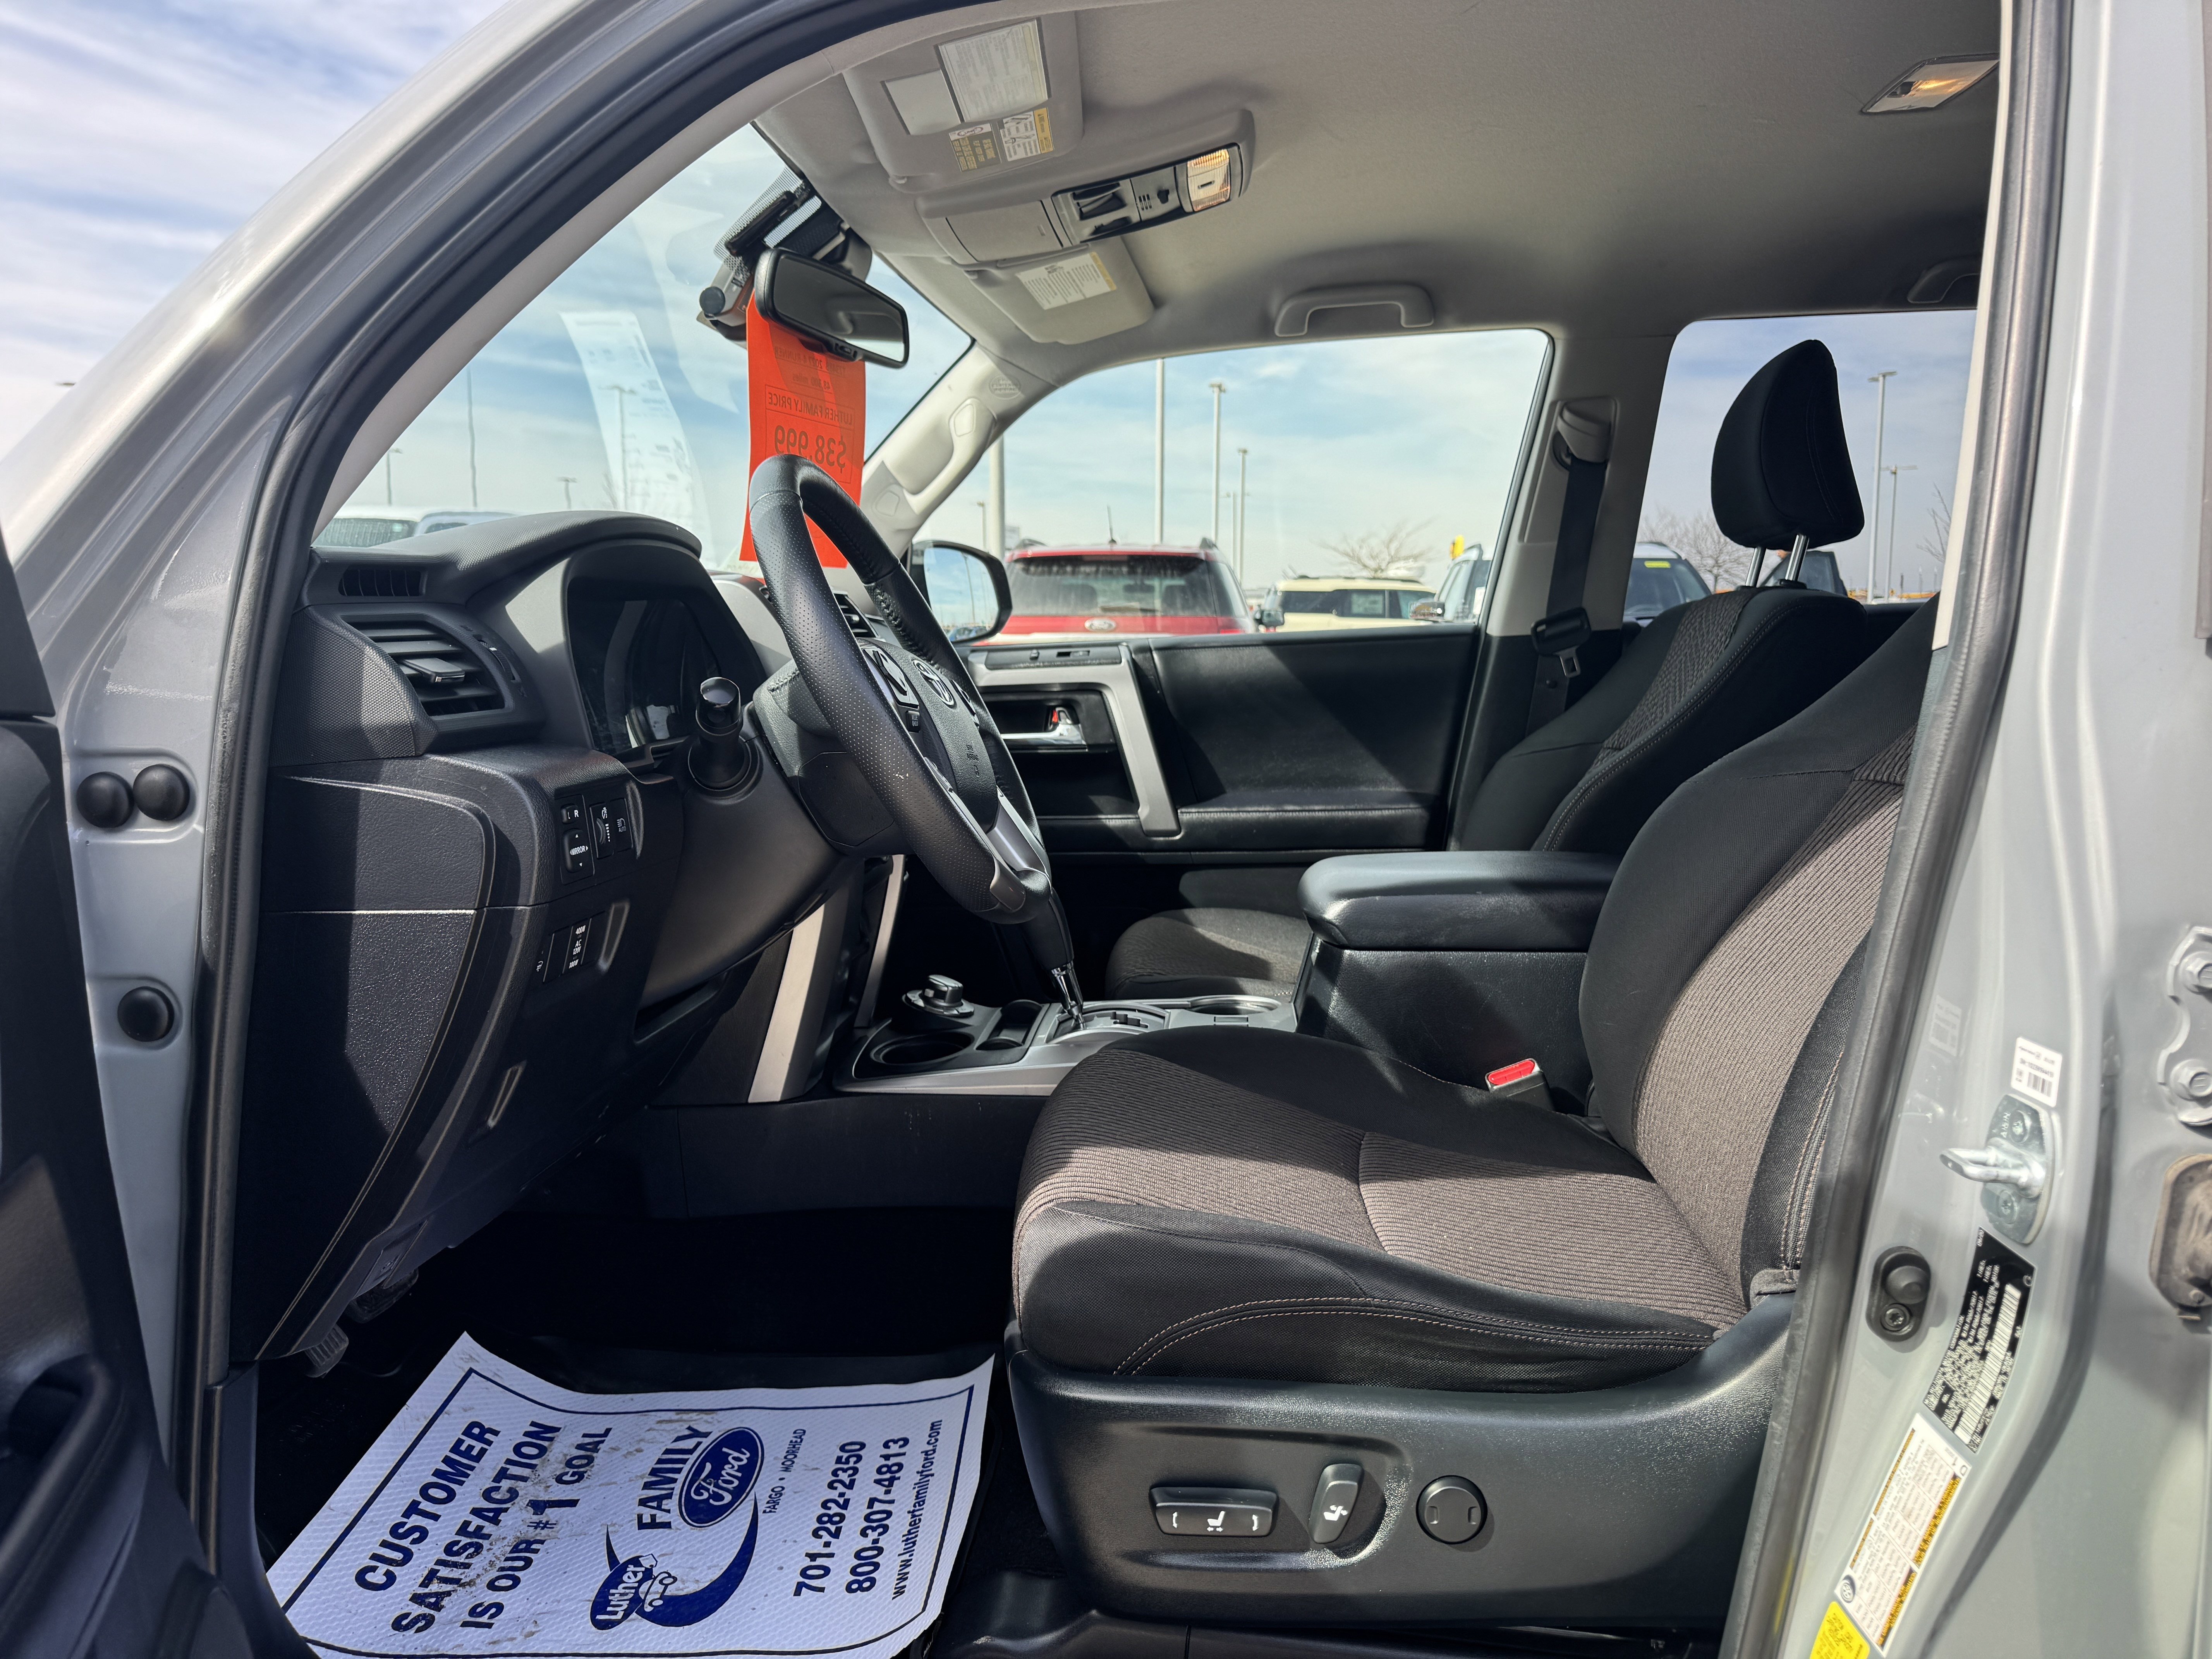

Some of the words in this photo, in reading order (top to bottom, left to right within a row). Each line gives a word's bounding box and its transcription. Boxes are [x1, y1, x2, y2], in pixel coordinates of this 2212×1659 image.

[575, 939, 582, 948] AC
[355, 1421, 501, 1592] CUSTOMER
[391, 1421, 562, 1633] SATISFACTION
[459, 1602, 505, 1629] IS
[486, 1538, 544, 1592] OUR
[527, 1499, 580, 1530] #1
[555, 1428, 612, 1485] GOAL
[637, 1425, 713, 1530] FAMILY
[690, 1447, 750, 1506] Ford
[763, 1486, 785, 1514] FARGO
[780, 1428, 807, 1473] MOORHEAD
[793, 1441, 867, 1597] 701-282-2350
[846, 1436, 910, 1594] 800-307-4813
[891, 1419, 943, 1601] www.lutherfamilyford.com
[597, 1564, 645, 1620] Luther
